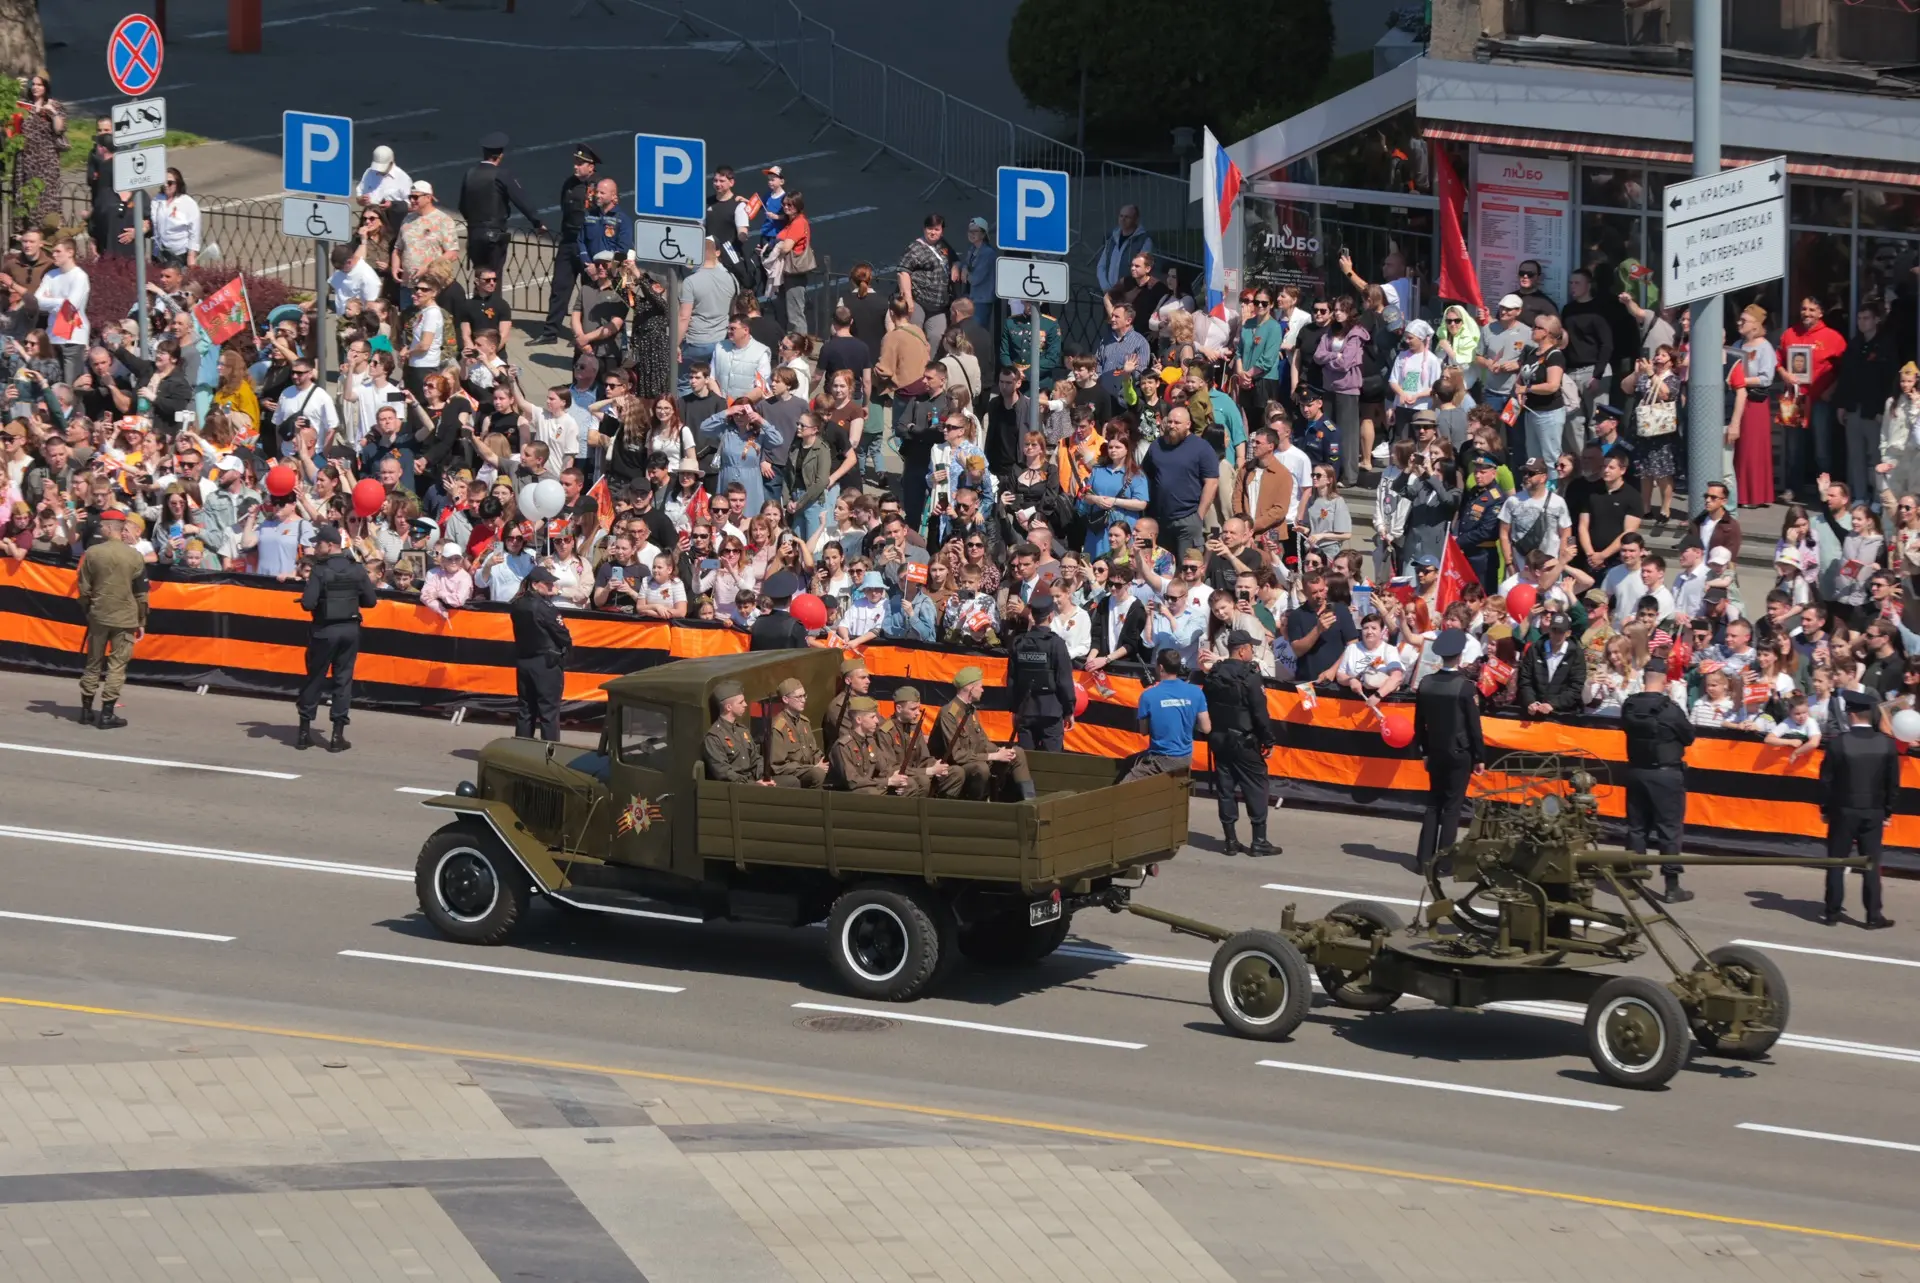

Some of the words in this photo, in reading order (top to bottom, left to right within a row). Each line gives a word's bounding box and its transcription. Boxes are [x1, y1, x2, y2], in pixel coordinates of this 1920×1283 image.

[302, 123, 339, 184] P
[655, 145, 692, 207] P
[1503, 167, 1543, 180] ЛЮБО
[1017, 178, 1055, 241] P
[1686, 195, 1698, 210] ул.
[1700, 180, 1744, 202] КРАСНАЯ
[1263, 233, 1319, 252] ЛЮБО
[1686, 235, 1698, 249] ул.
[1700, 211, 1773, 241] РАШПИЛЕВСКАЯ
[1686, 258, 1698, 272] ул.
[1700, 237, 1763, 265] ОКТЯБРЬСКАЯ
[1686, 281, 1697, 296] ул.
[1700, 267, 1735, 287] ФРУНЗЕ
